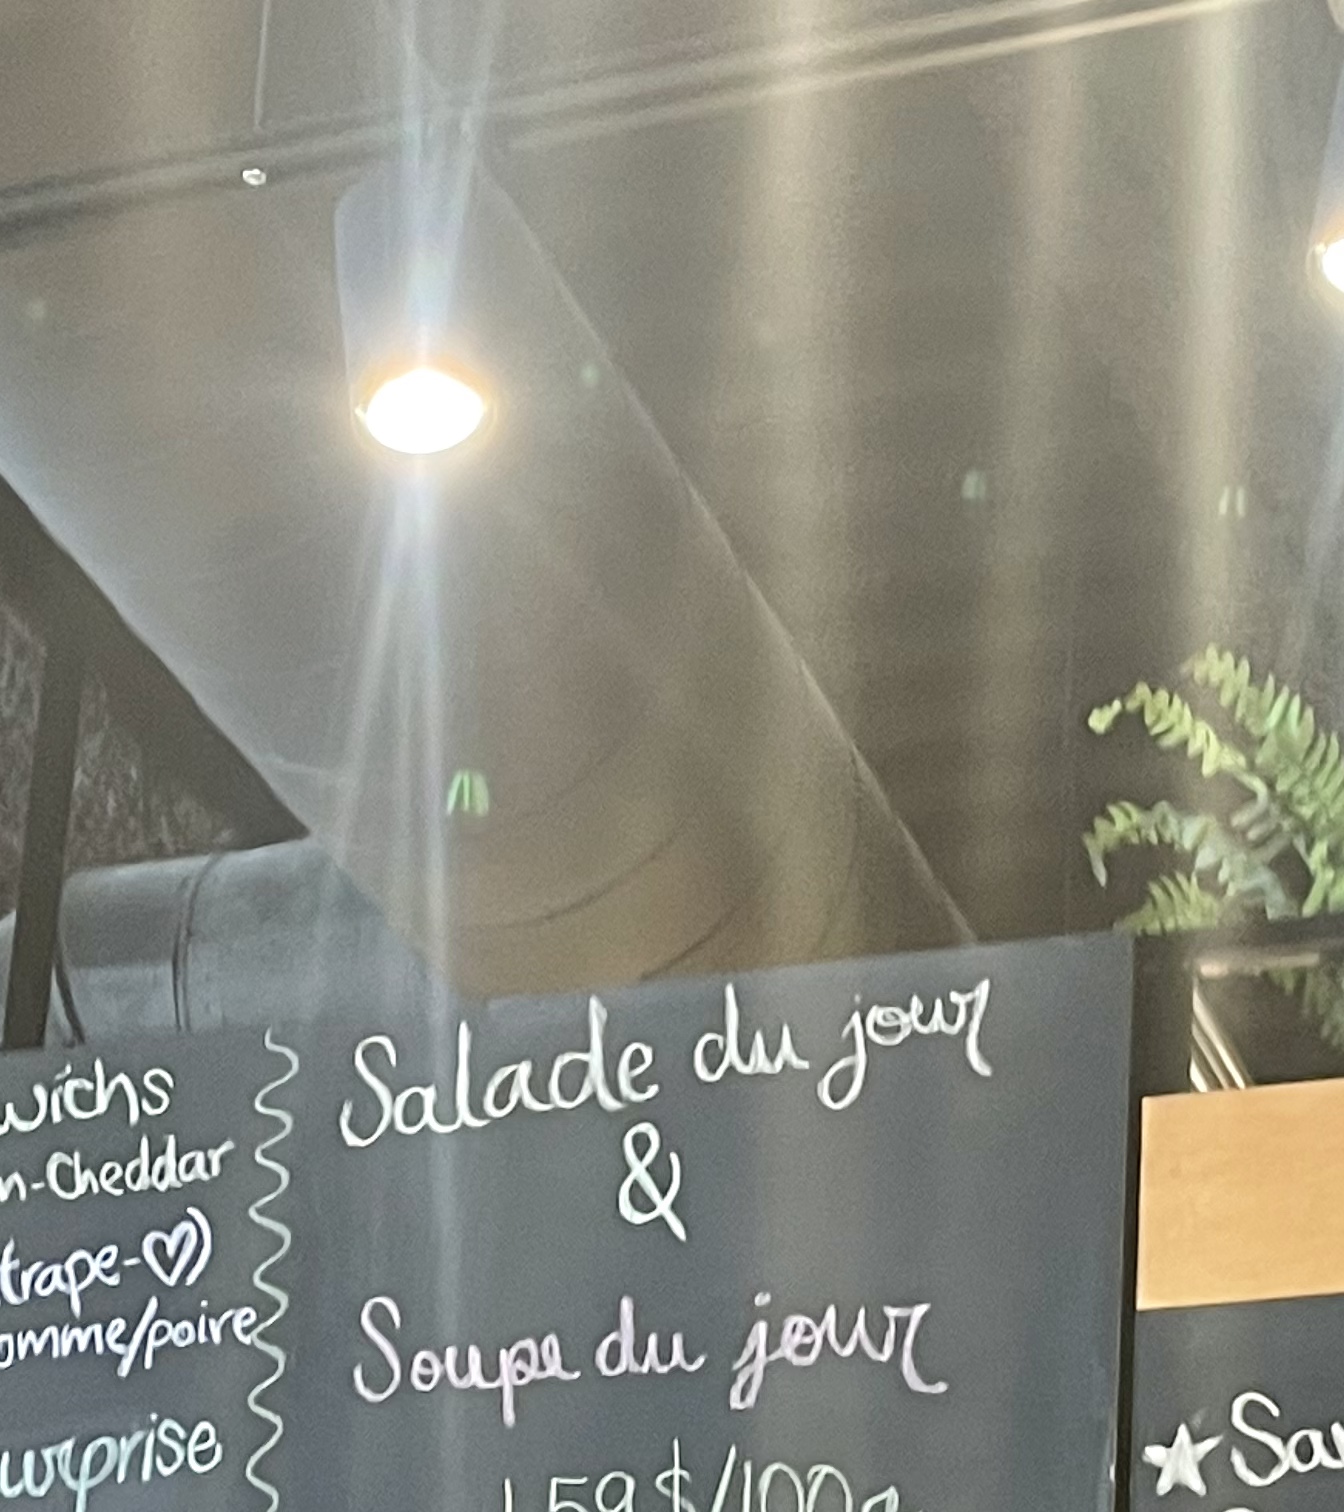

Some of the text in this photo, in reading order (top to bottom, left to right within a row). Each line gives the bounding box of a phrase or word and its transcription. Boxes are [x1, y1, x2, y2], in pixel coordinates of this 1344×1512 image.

[340, 978, 993, 1147] Salade du jour
[617, 1121, 686, 1241] &
[353, 1291, 949, 1428] Soupe du jour
